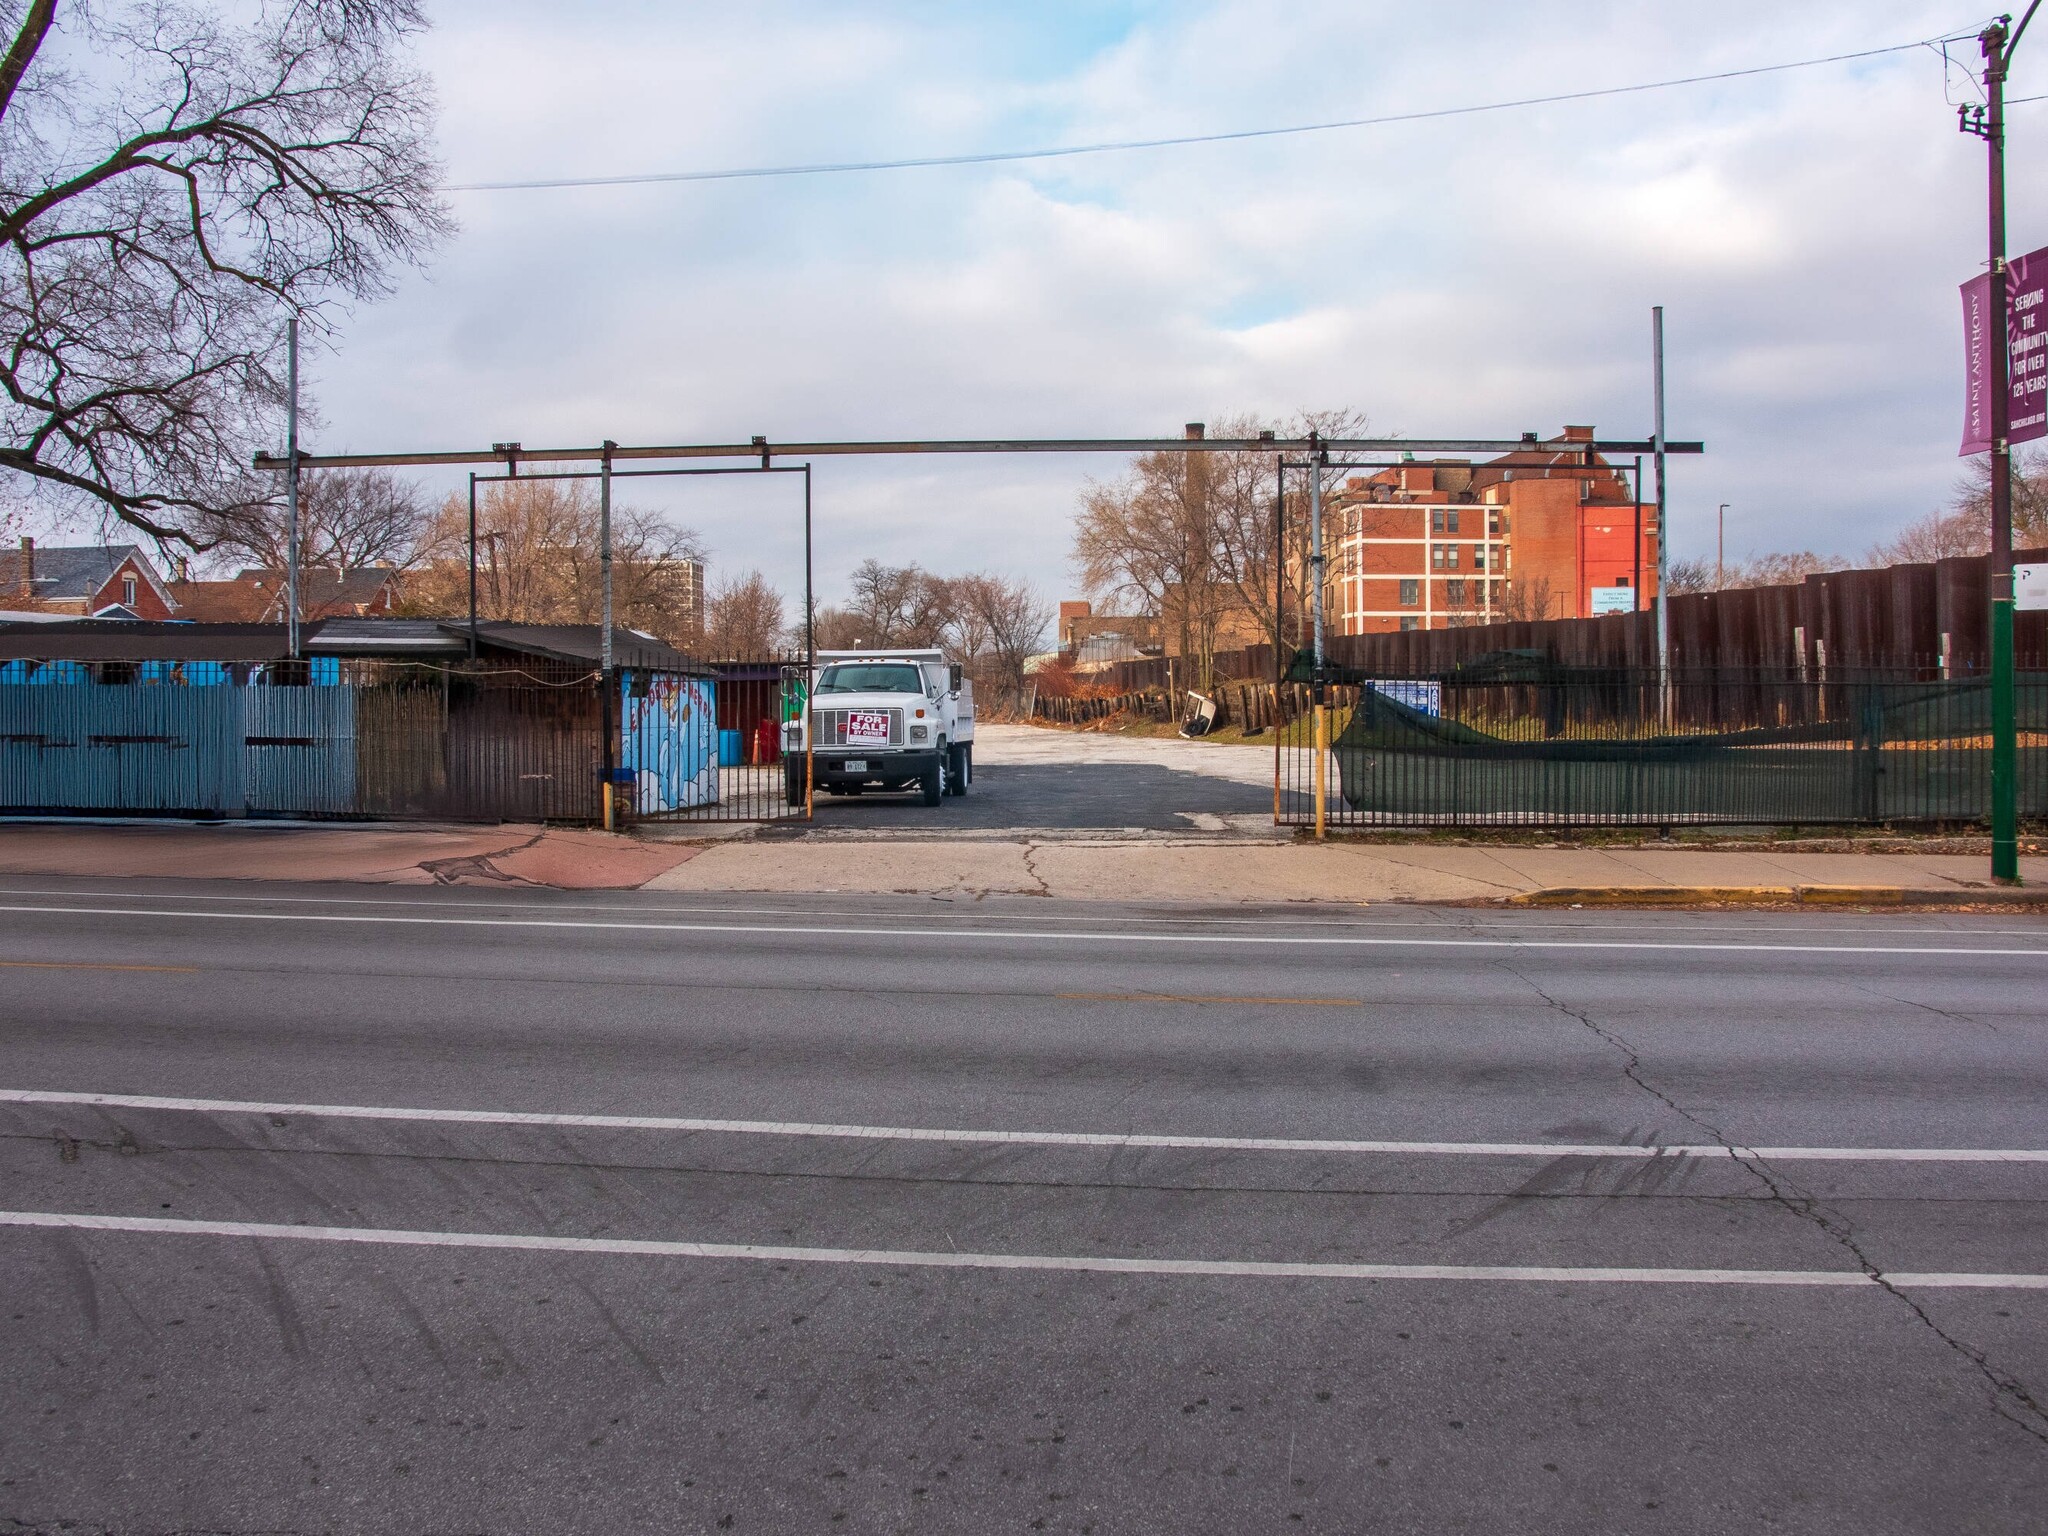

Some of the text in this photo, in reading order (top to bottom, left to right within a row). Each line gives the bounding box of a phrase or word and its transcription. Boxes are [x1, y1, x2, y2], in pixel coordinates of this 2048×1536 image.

[2015, 288, 2044, 311] SERVING
[2022, 313, 2036, 331] THE
[2012, 331, 2048, 355] COMMUNITY
[1971, 294, 1980, 427] SAINT ANTHONY
[2014, 359, 2026, 376] FOR
[2013, 374, 2047, 398] 125 YEARS
[851, 722, 886, 732] SALE
[856, 715, 882, 723] FOR
